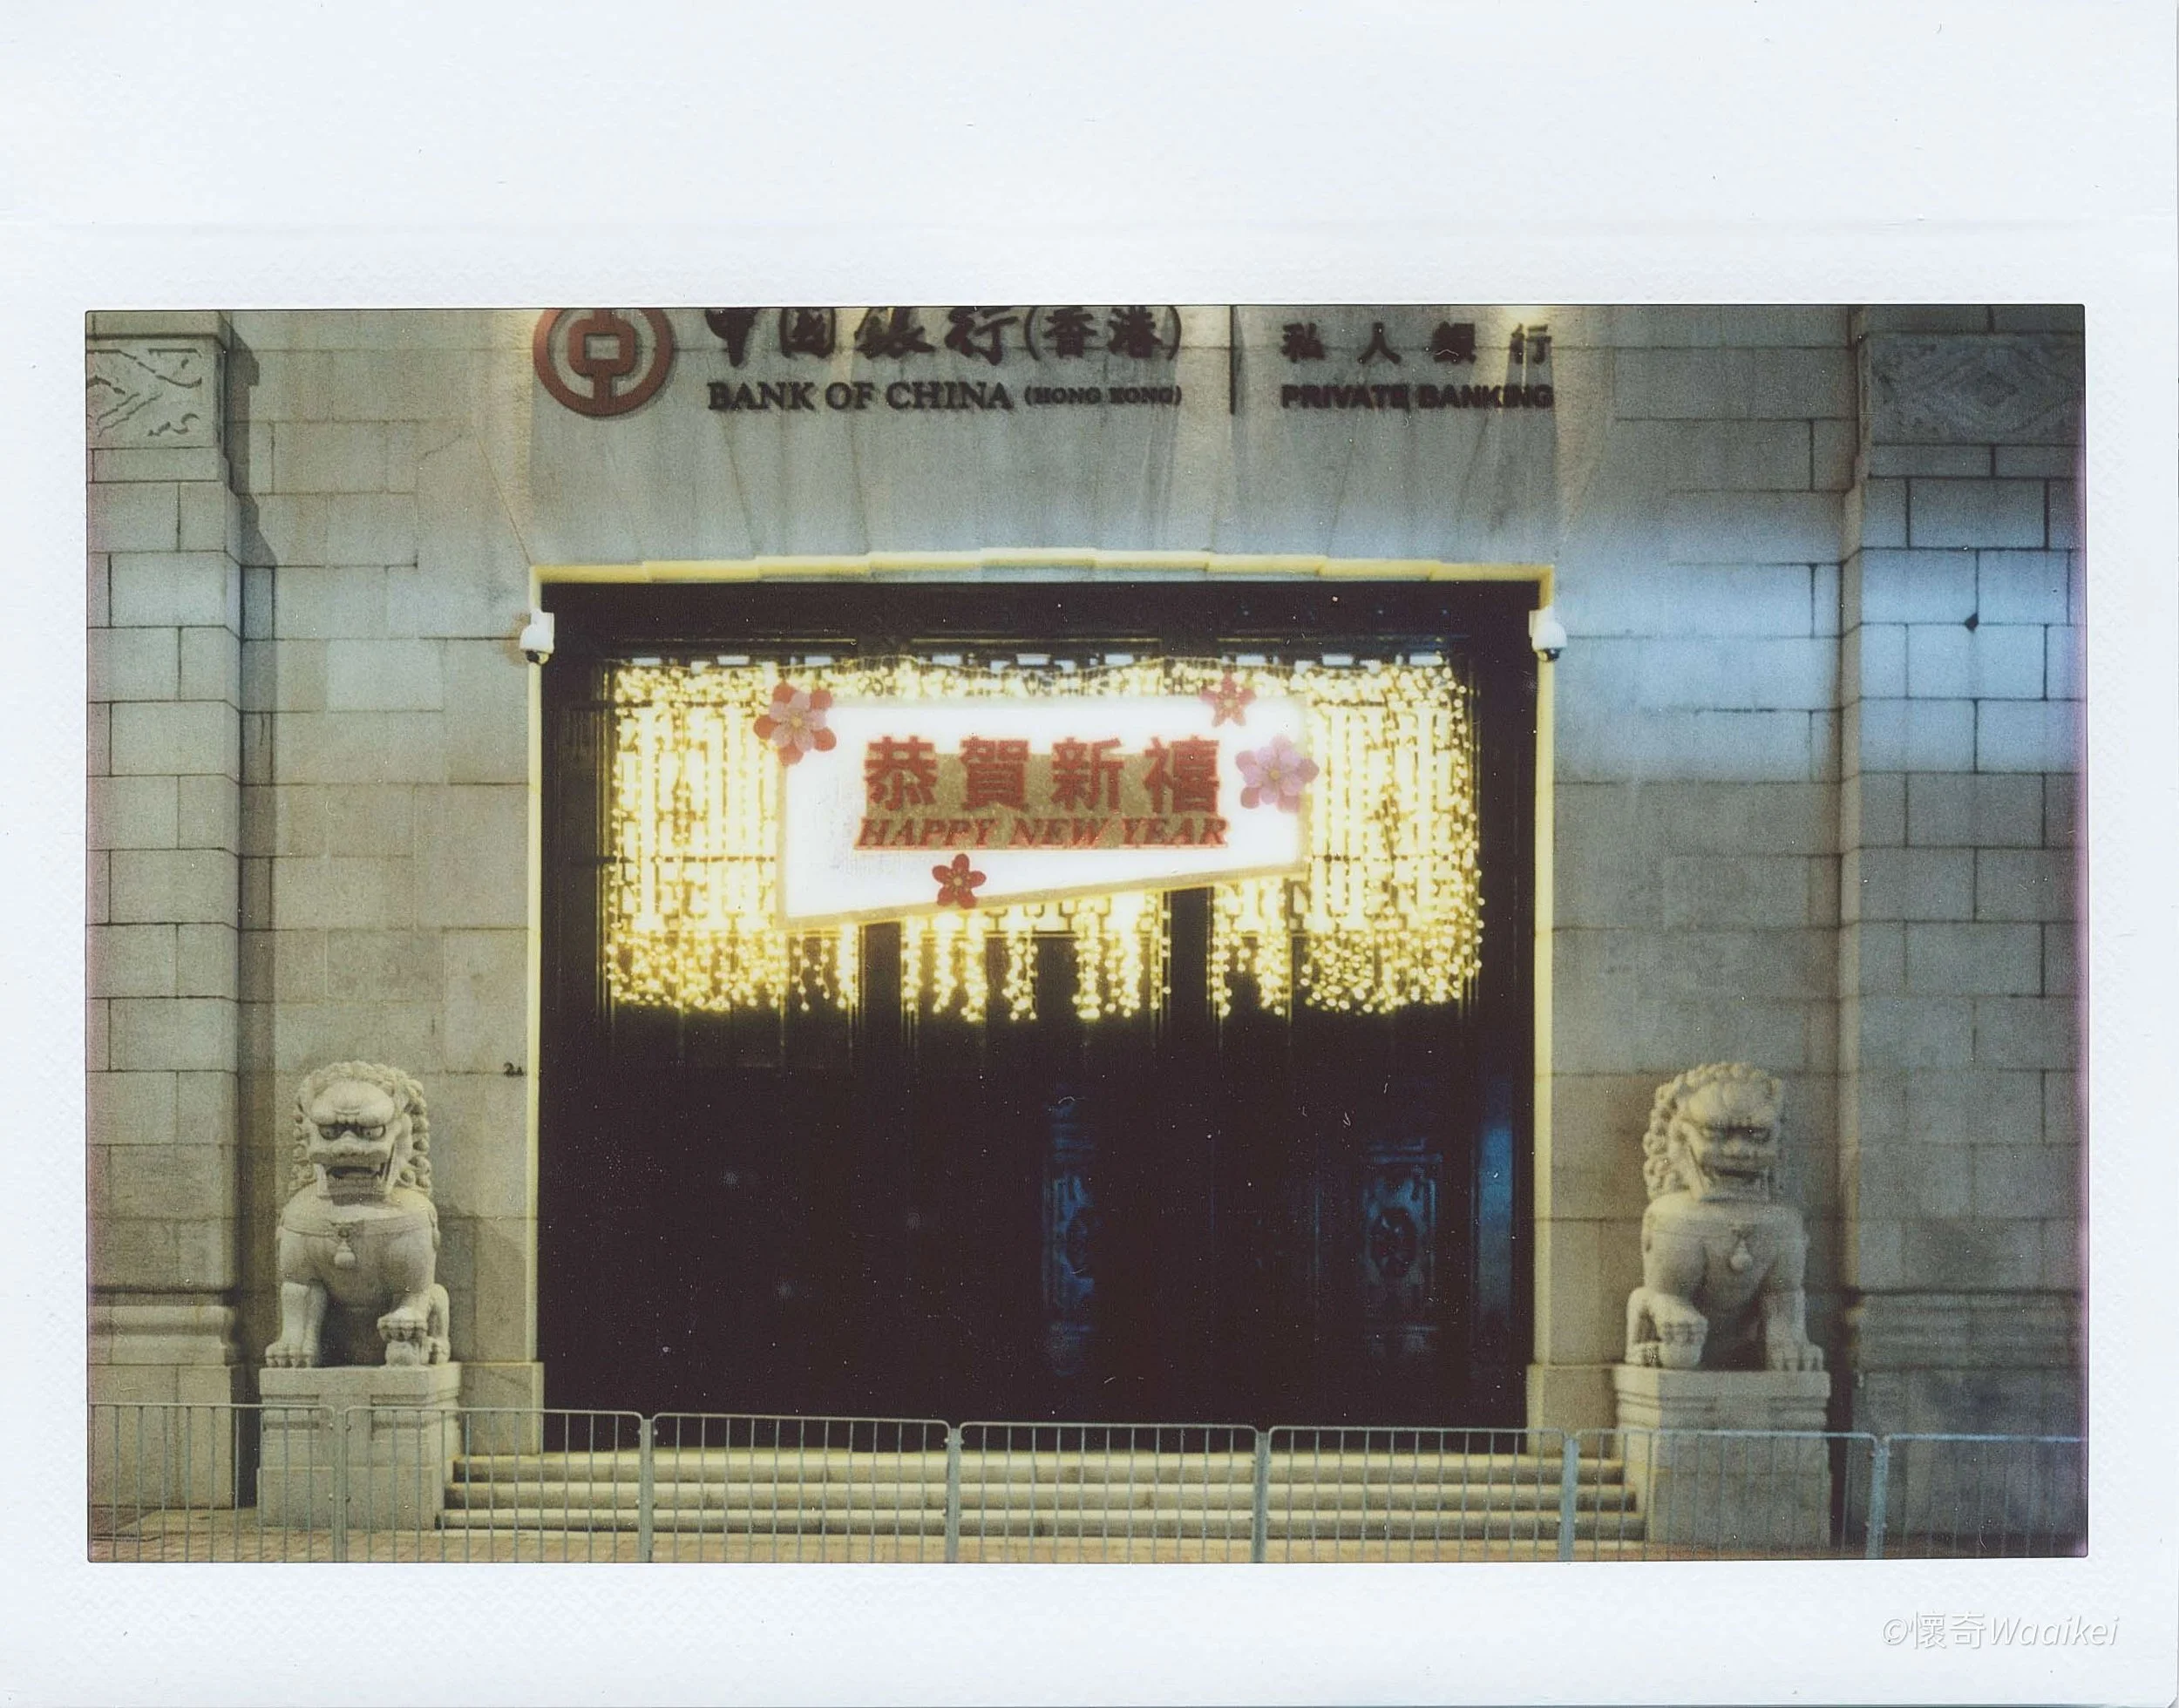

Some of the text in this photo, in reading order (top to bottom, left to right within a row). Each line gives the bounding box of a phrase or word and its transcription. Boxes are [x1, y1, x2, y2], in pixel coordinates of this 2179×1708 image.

[707, 382, 815, 410] BANK
[825, 382, 874, 410] OF
[886, 382, 1015, 410] CHINA
[1024, 386, 1102, 406] (HONG
[1282, 384, 1554, 409] PRIVATE BANKING
[864, 735, 1220, 813] 恭賀新禧
[855, 817, 1229, 849] HAPPY NEW YEAR
